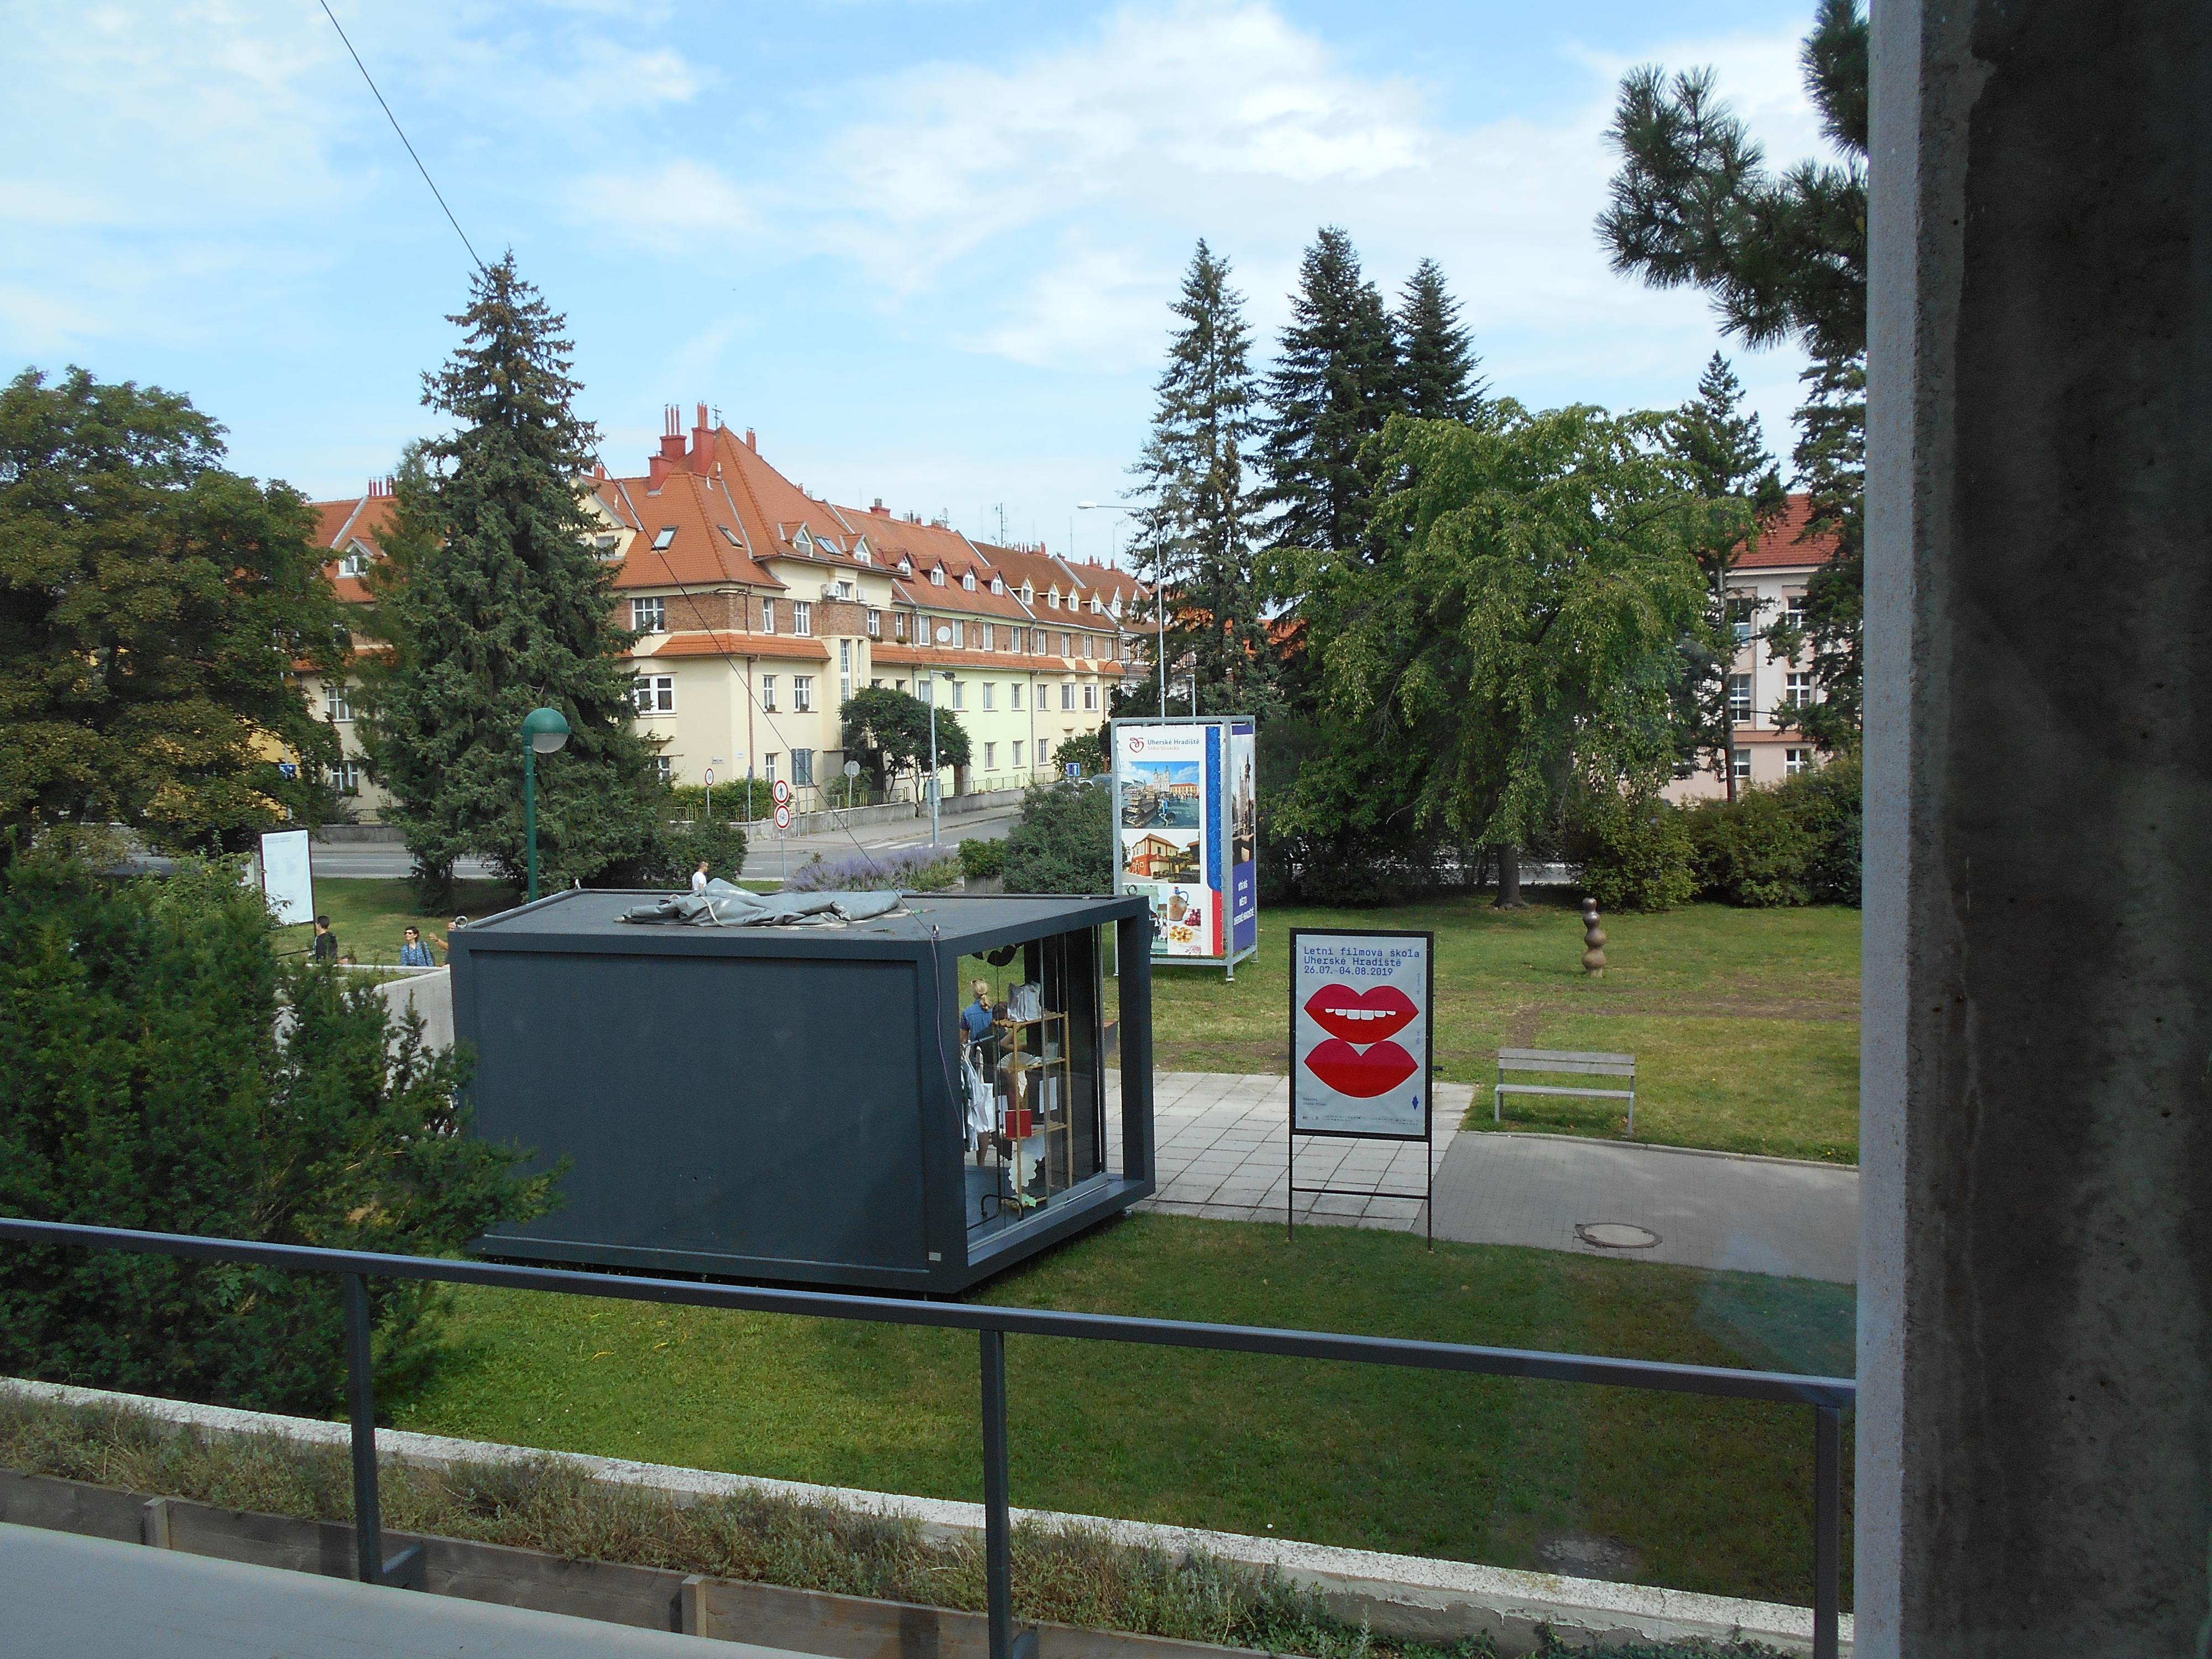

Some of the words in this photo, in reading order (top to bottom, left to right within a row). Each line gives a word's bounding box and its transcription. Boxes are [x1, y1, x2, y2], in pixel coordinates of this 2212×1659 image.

[1304, 947, 1333, 955] Letní
[1340, 947, 1383, 956] filmová
[1390, 948, 1420, 957] škola
[1304, 956, 1346, 965] Uherské
[1353, 957, 1401, 967] Hradiště
